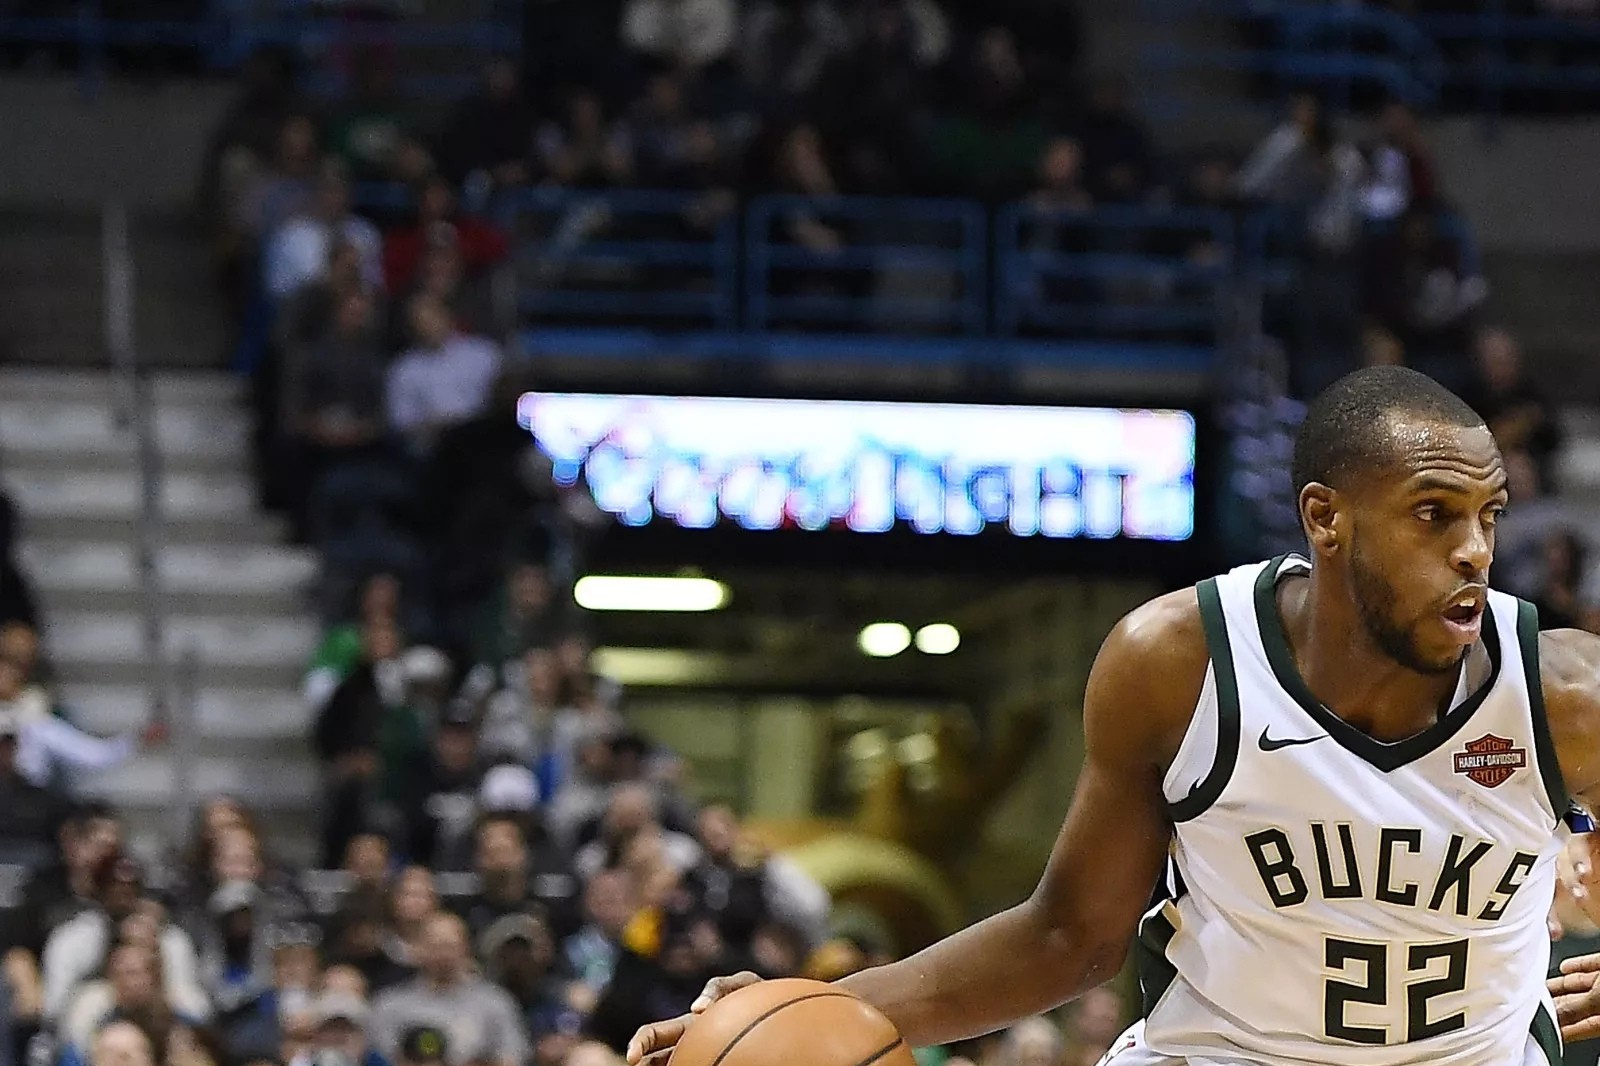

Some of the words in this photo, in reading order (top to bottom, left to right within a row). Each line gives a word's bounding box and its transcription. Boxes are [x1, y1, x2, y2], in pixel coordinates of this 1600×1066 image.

[1458, 753, 1522, 769] HARLEY-DAVIDSON
[1244, 820, 1539, 921] BUCKS
[1323, 936, 1470, 1045] 22
